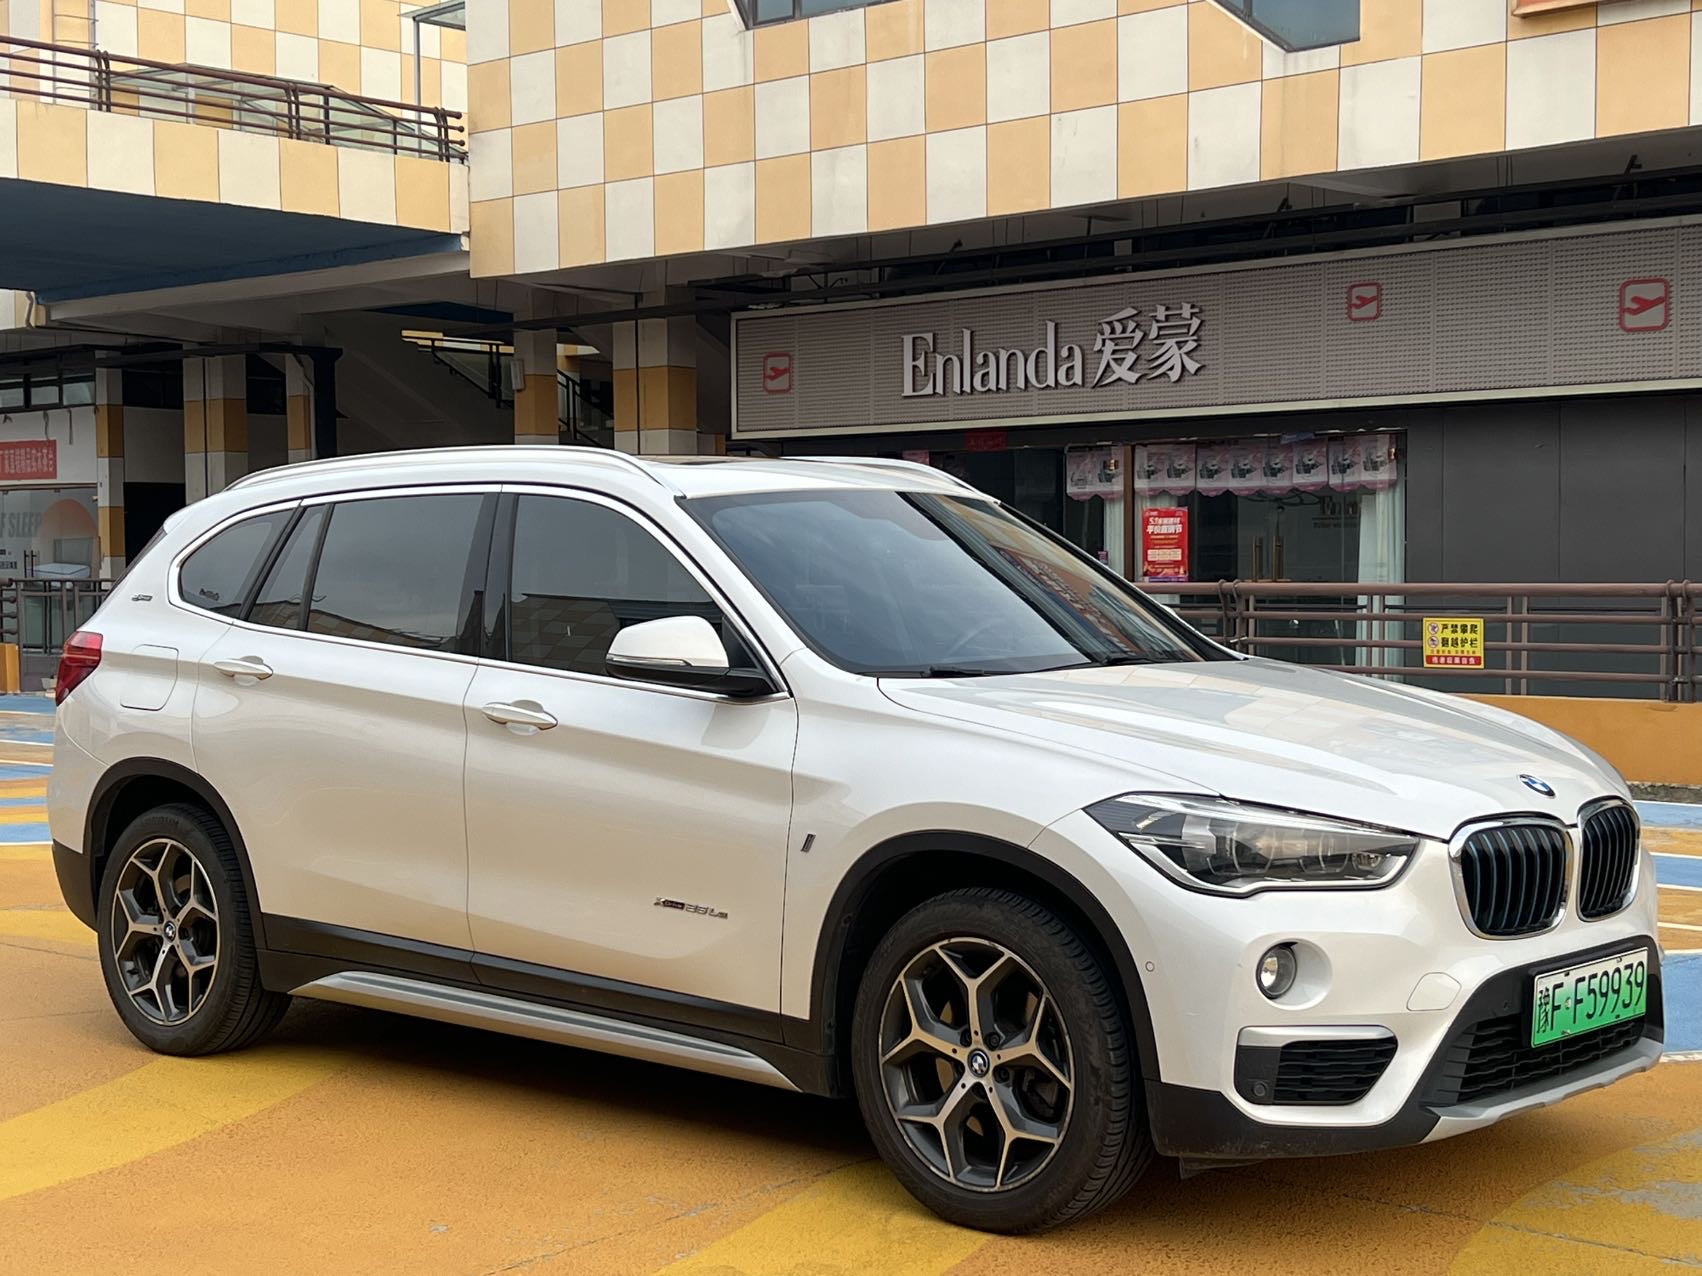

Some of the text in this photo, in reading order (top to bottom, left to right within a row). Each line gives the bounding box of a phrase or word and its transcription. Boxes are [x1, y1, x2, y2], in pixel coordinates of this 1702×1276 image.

[901, 303, 1202, 397] Enlanda 爱蒙
[1440, 623, 1478, 635] 严禁攀爬
[1441, 636, 1478, 648] 翻越护栏
